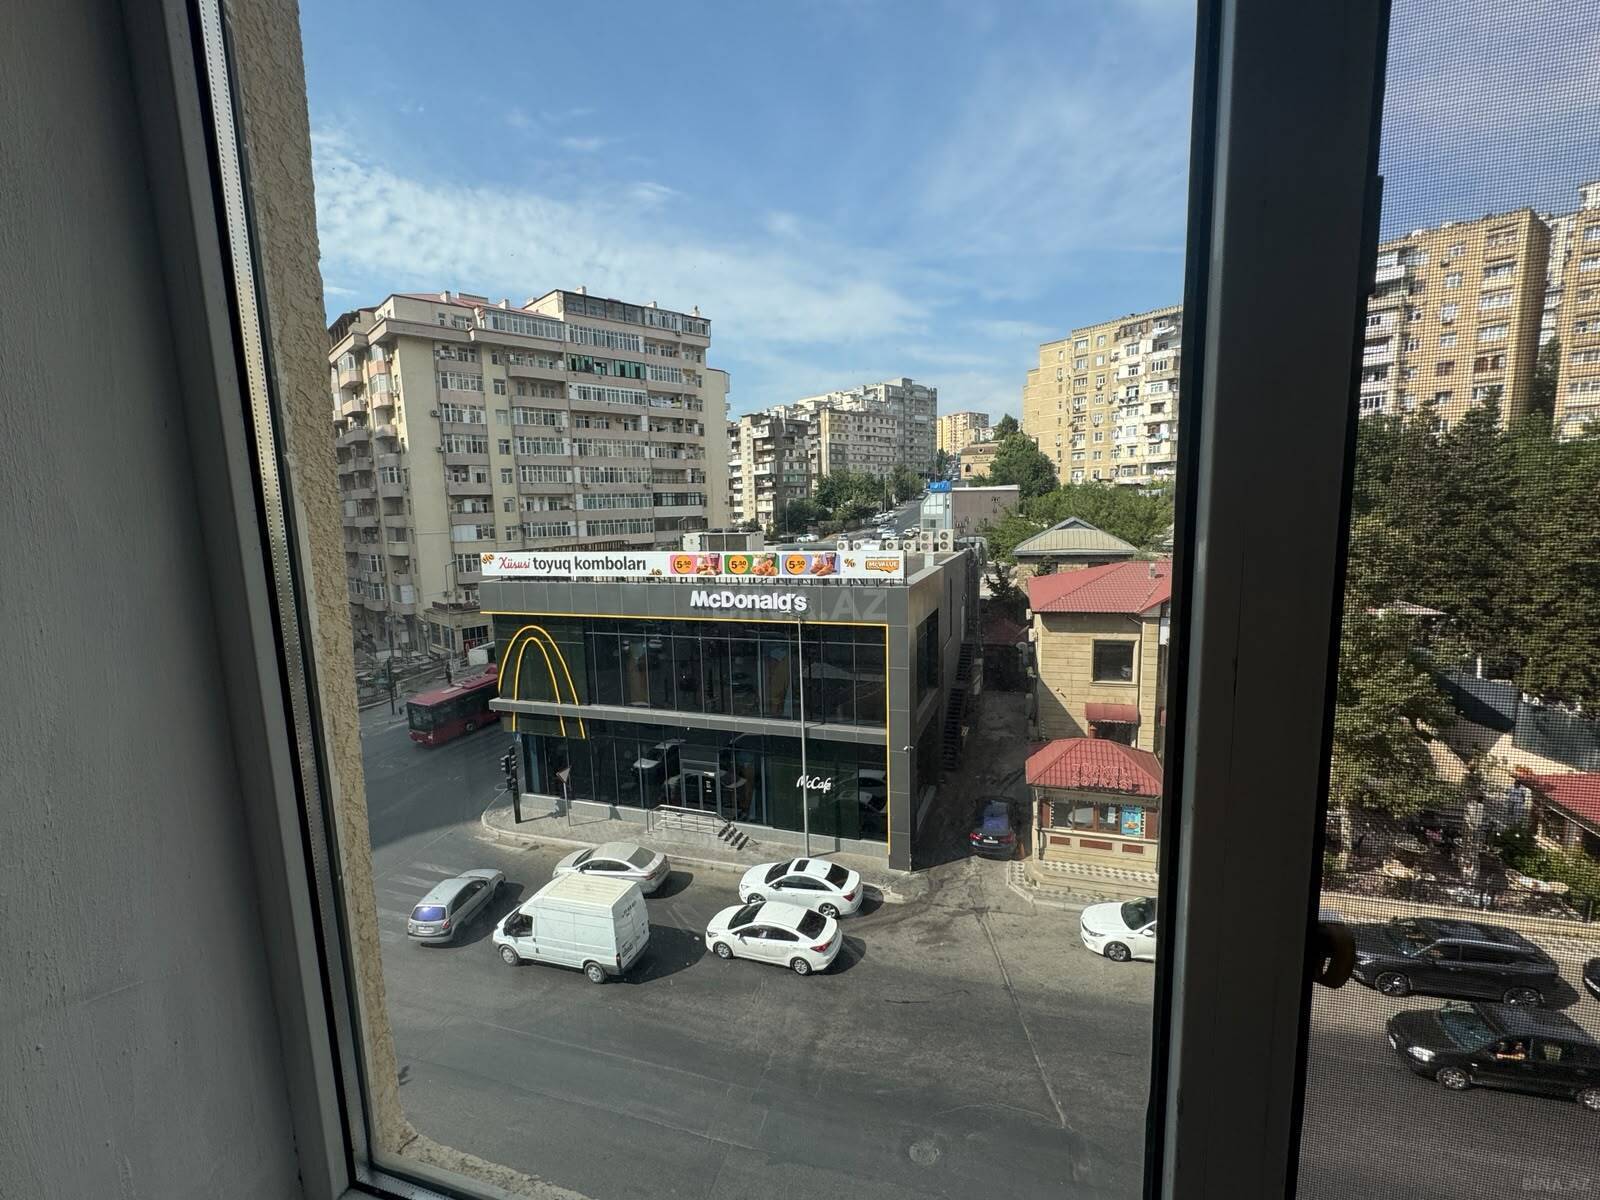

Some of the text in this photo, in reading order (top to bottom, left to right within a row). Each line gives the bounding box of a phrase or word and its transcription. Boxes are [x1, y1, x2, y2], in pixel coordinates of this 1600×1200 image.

[498, 556, 647, 573] Xüsusi toyuq komboları
[690, 590, 808, 611] McDonald's
